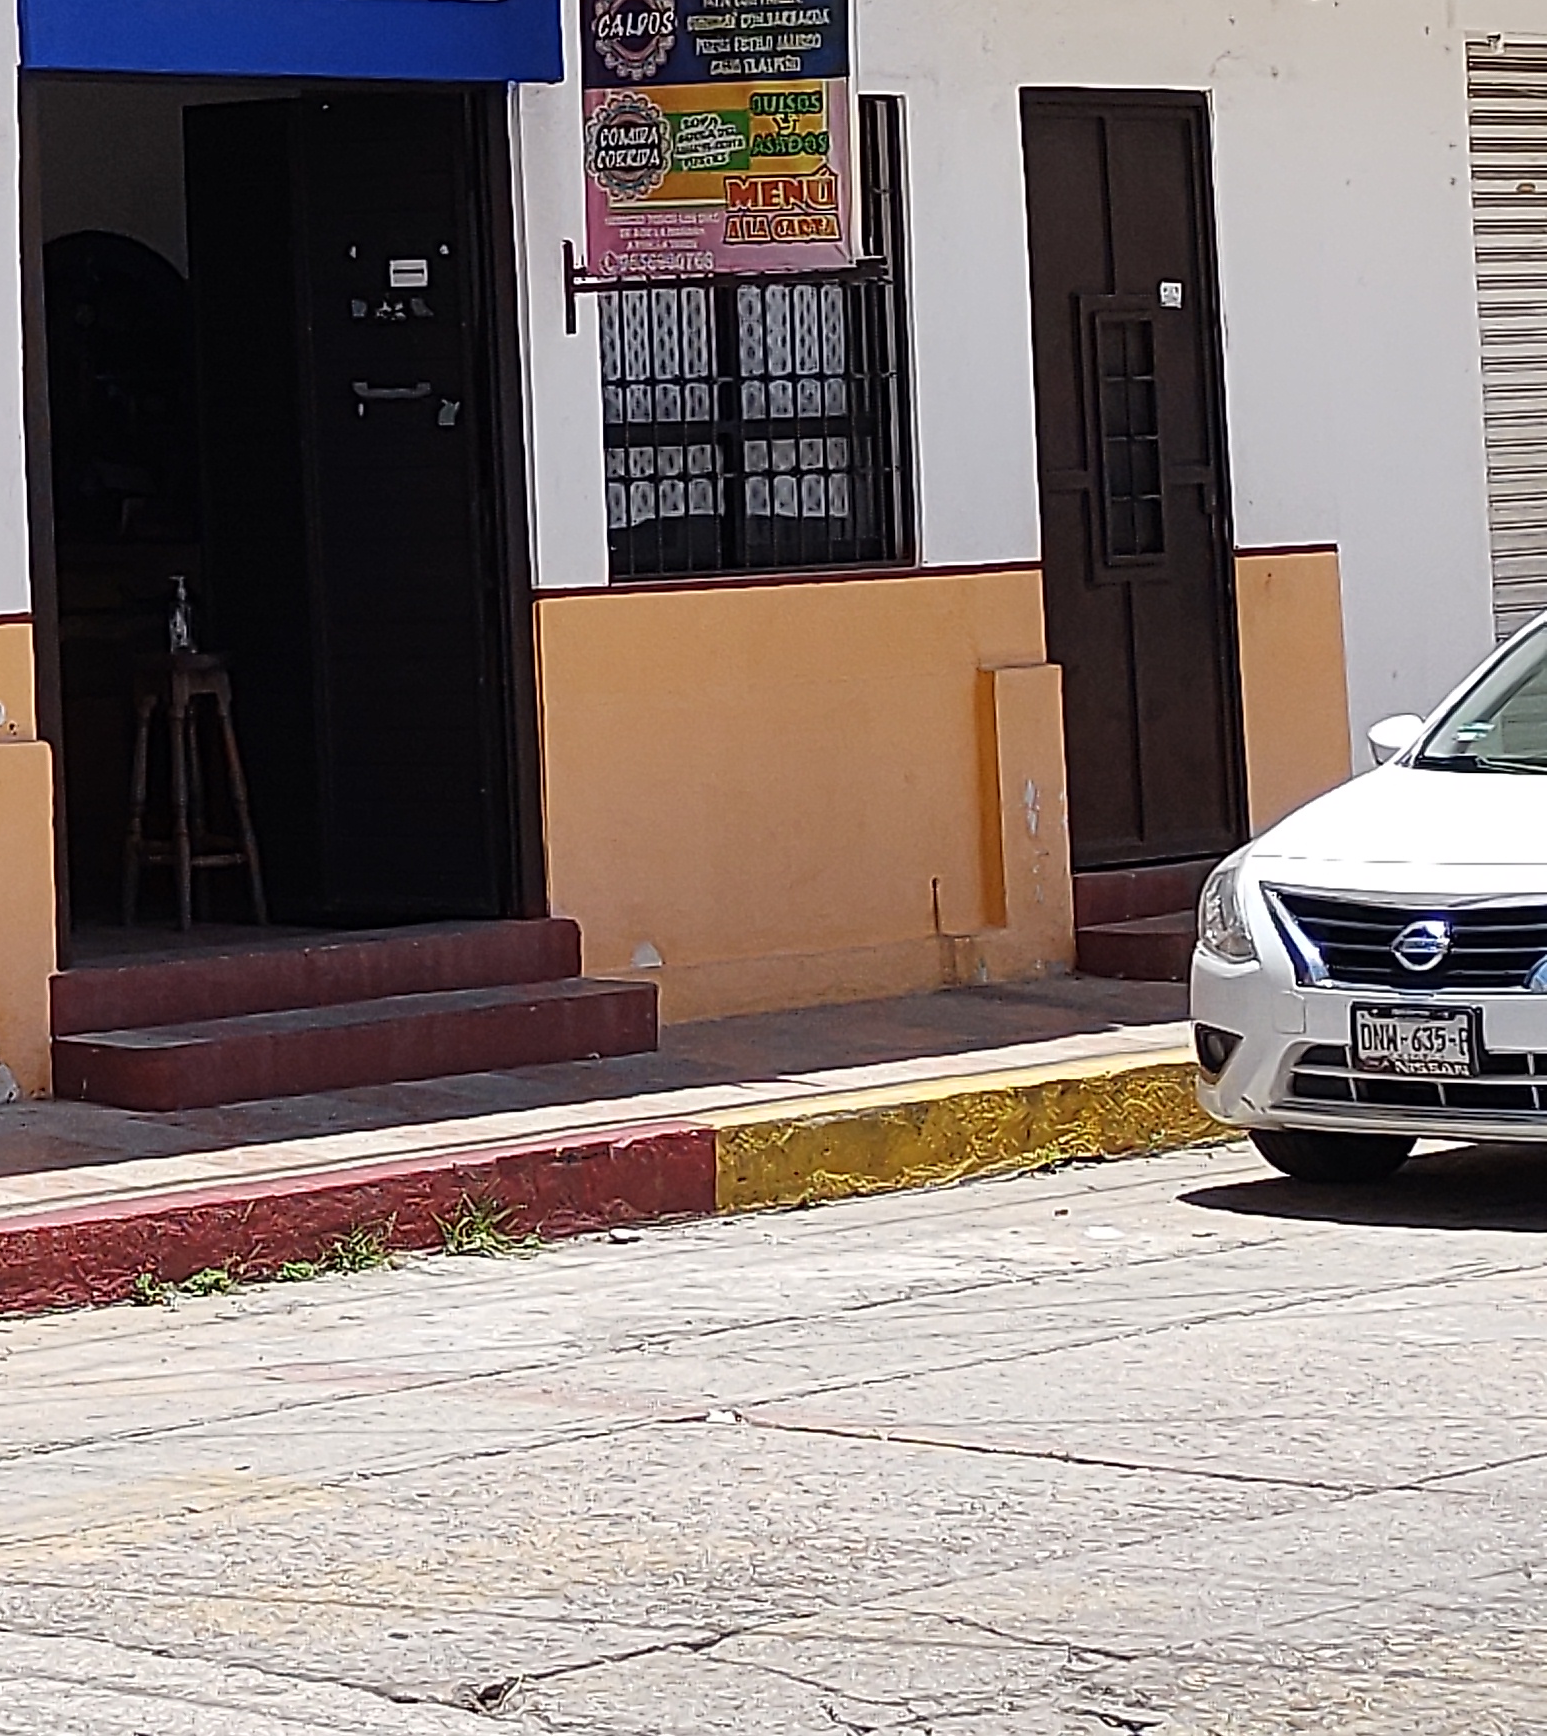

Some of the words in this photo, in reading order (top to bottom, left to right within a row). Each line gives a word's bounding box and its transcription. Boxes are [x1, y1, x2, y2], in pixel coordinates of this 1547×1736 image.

[597, 11, 675, 40] CALDOS
[753, 134, 827, 154] ASADOS
[726, 168, 835, 209] MENÚ
[743, 217, 770, 240] LA
